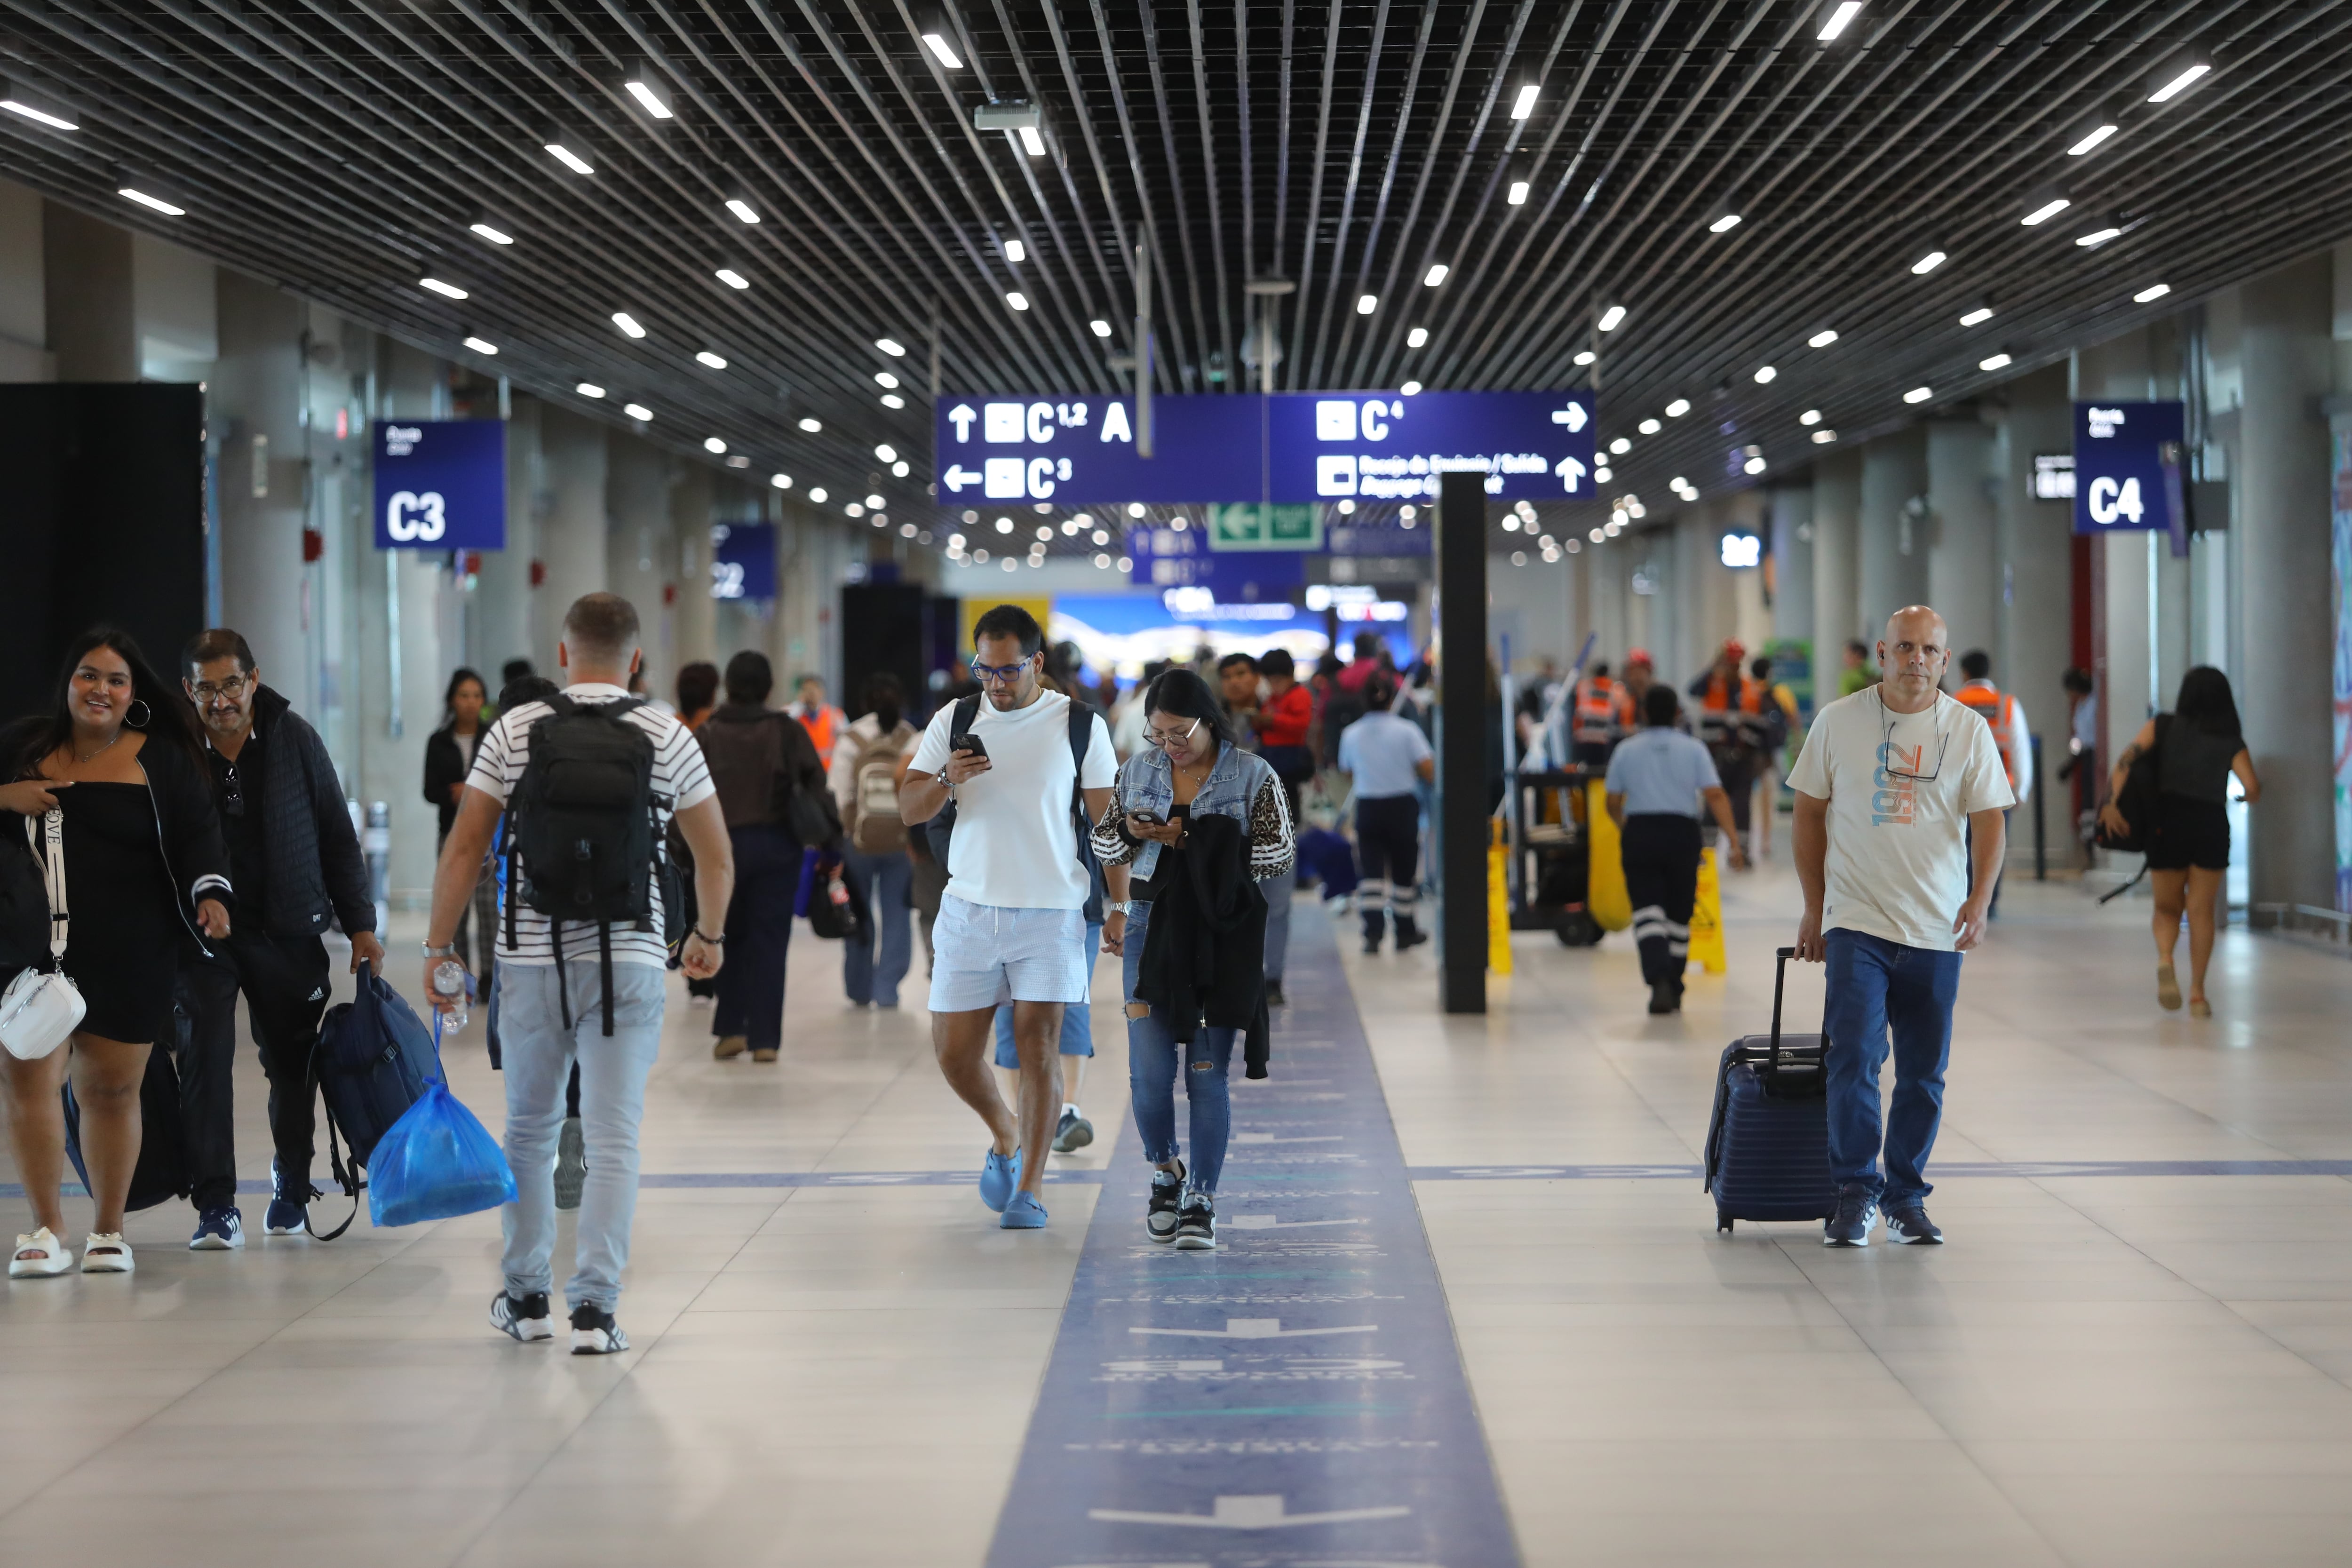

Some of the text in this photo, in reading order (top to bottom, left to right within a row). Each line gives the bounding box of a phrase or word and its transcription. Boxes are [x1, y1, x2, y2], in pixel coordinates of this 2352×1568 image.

[1100, 402, 1132, 442] A
[387, 491, 446, 541] C3
[2089, 476, 2144, 524] C4
[1872, 742, 1917, 827] 1962
